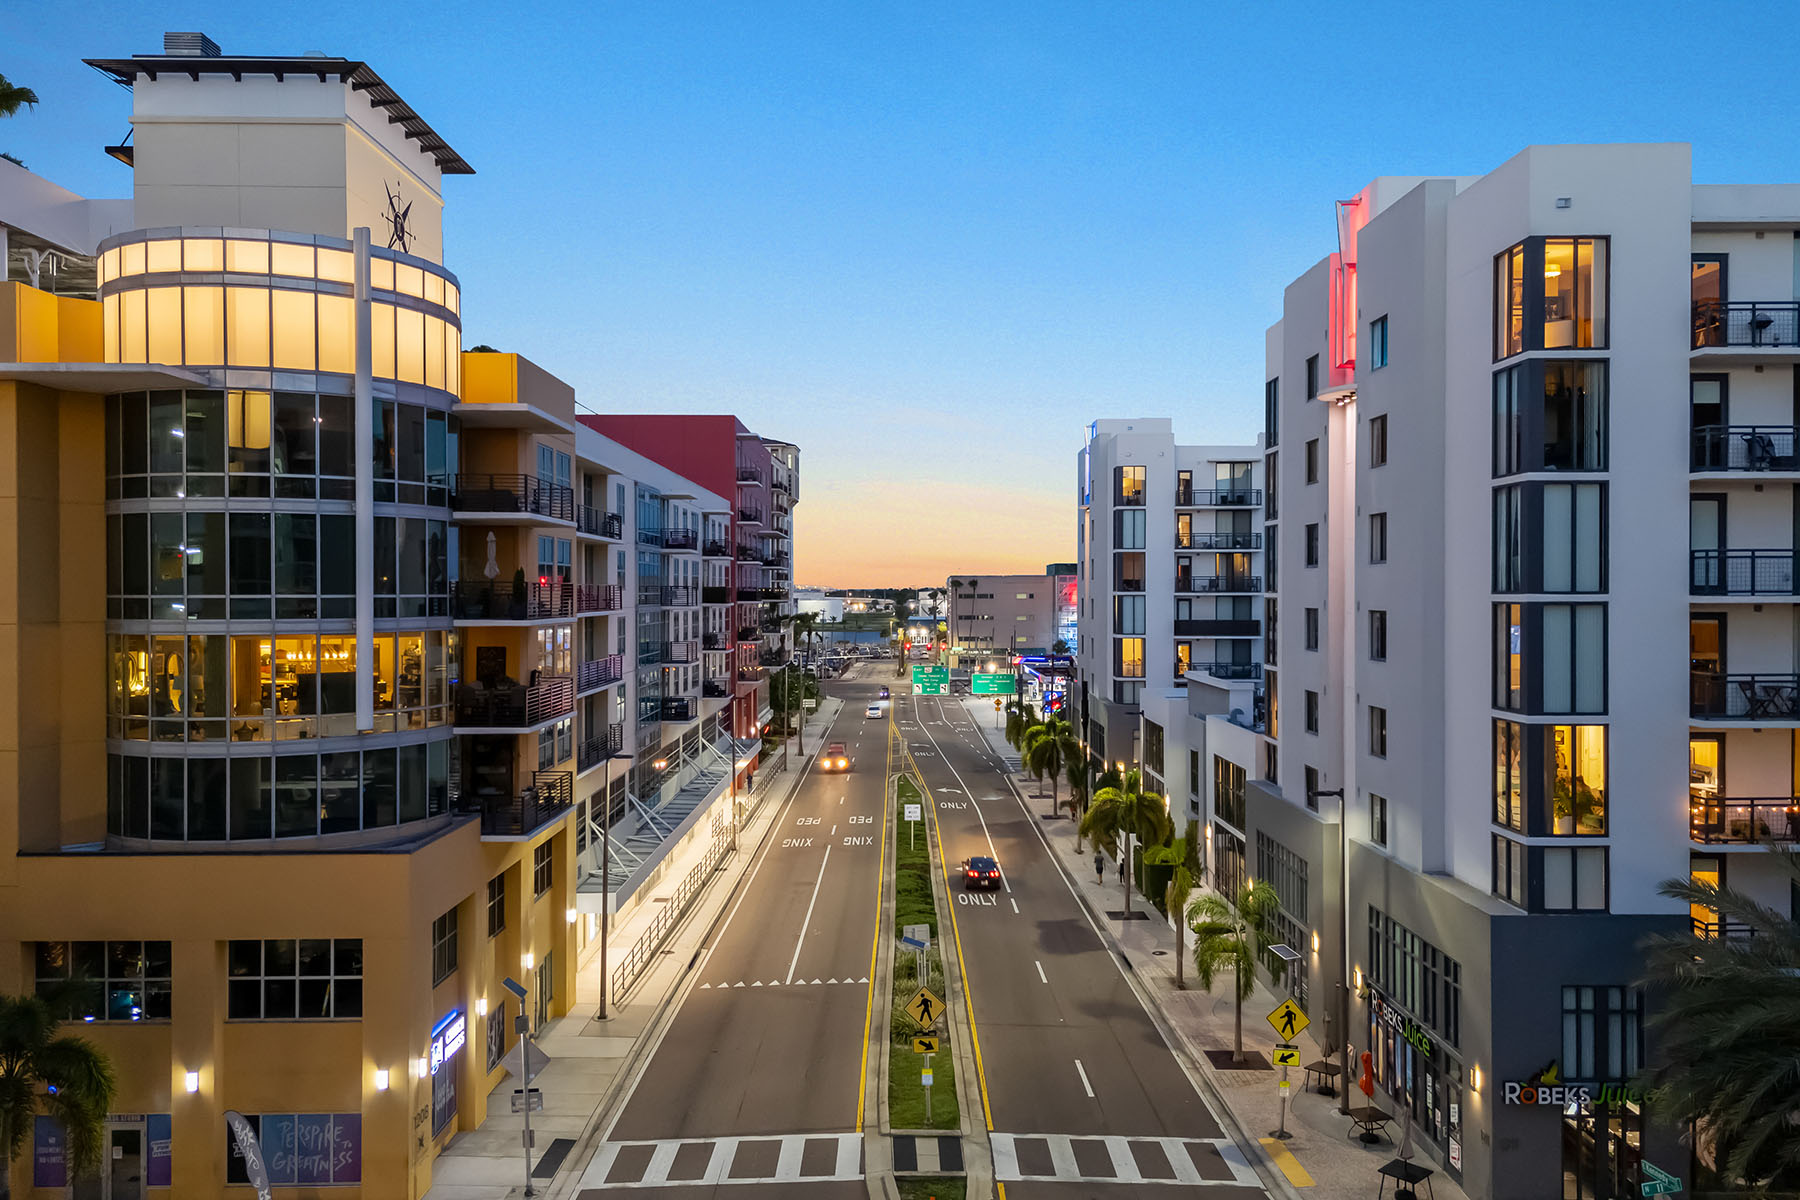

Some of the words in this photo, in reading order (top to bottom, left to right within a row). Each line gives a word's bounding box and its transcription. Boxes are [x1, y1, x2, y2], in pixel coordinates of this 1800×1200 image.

[940, 801, 967, 809] ONLY
[796, 817, 822, 825] PED
[848, 816, 873, 824] PED
[782, 838, 813, 848] XING
[843, 836, 873, 846] XING
[958, 893, 997, 906] ONLY
[1371, 988, 1403, 1034] ROBEKS
[1505, 1082, 1590, 1105] ROBEKS
[277, 1121, 343, 1150] PERSPIRE
